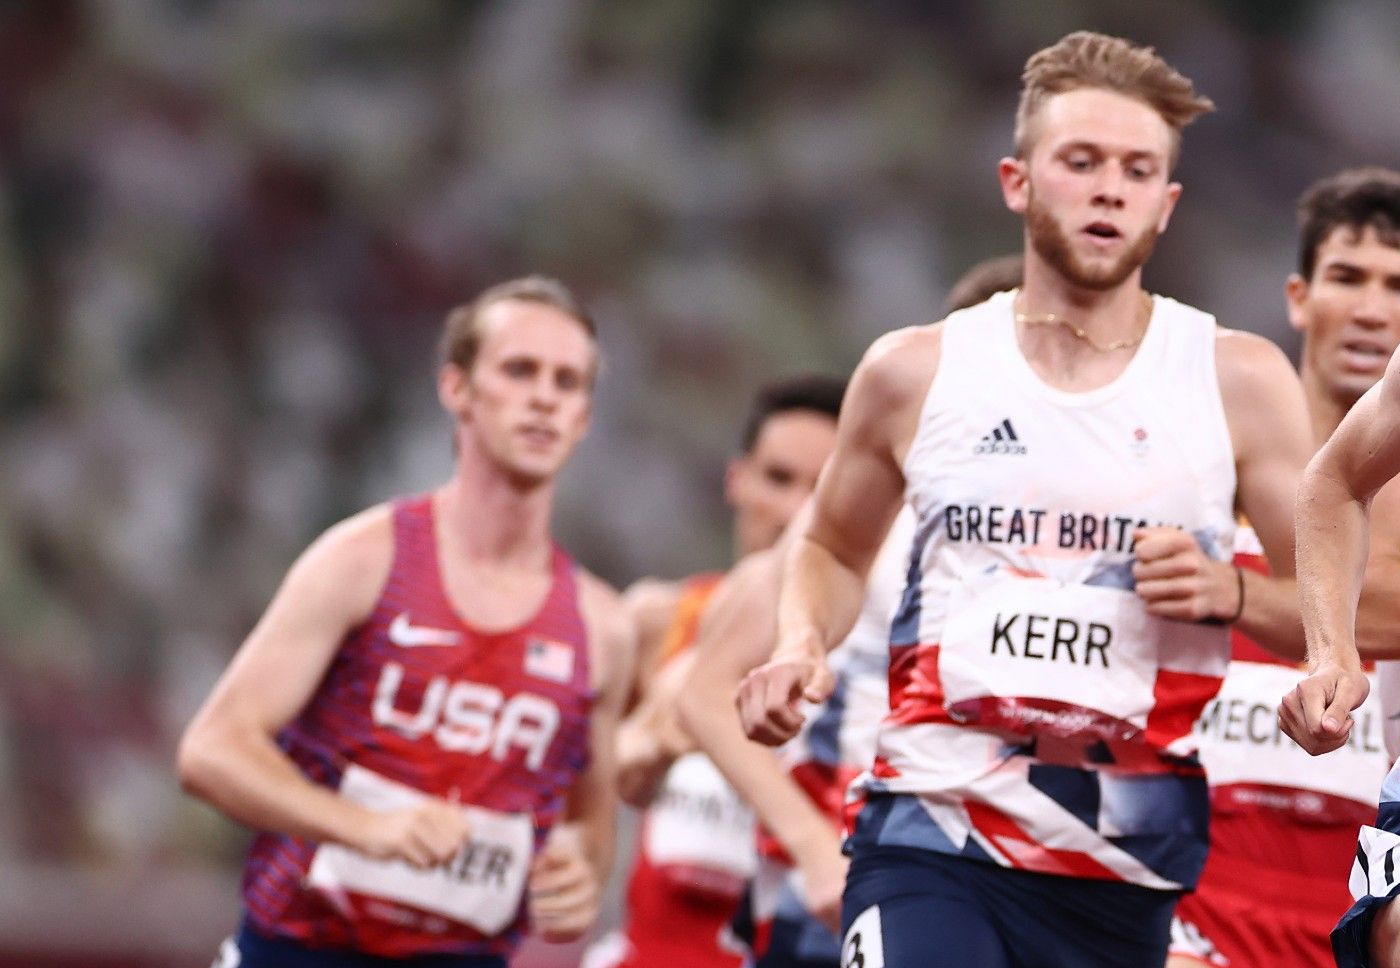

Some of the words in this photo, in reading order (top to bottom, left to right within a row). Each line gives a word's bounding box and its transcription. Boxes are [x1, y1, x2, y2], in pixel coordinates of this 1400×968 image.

[945, 504, 1047, 544] GREAT
[991, 613, 1112, 668] KERR
[373, 662, 560, 772] USA
